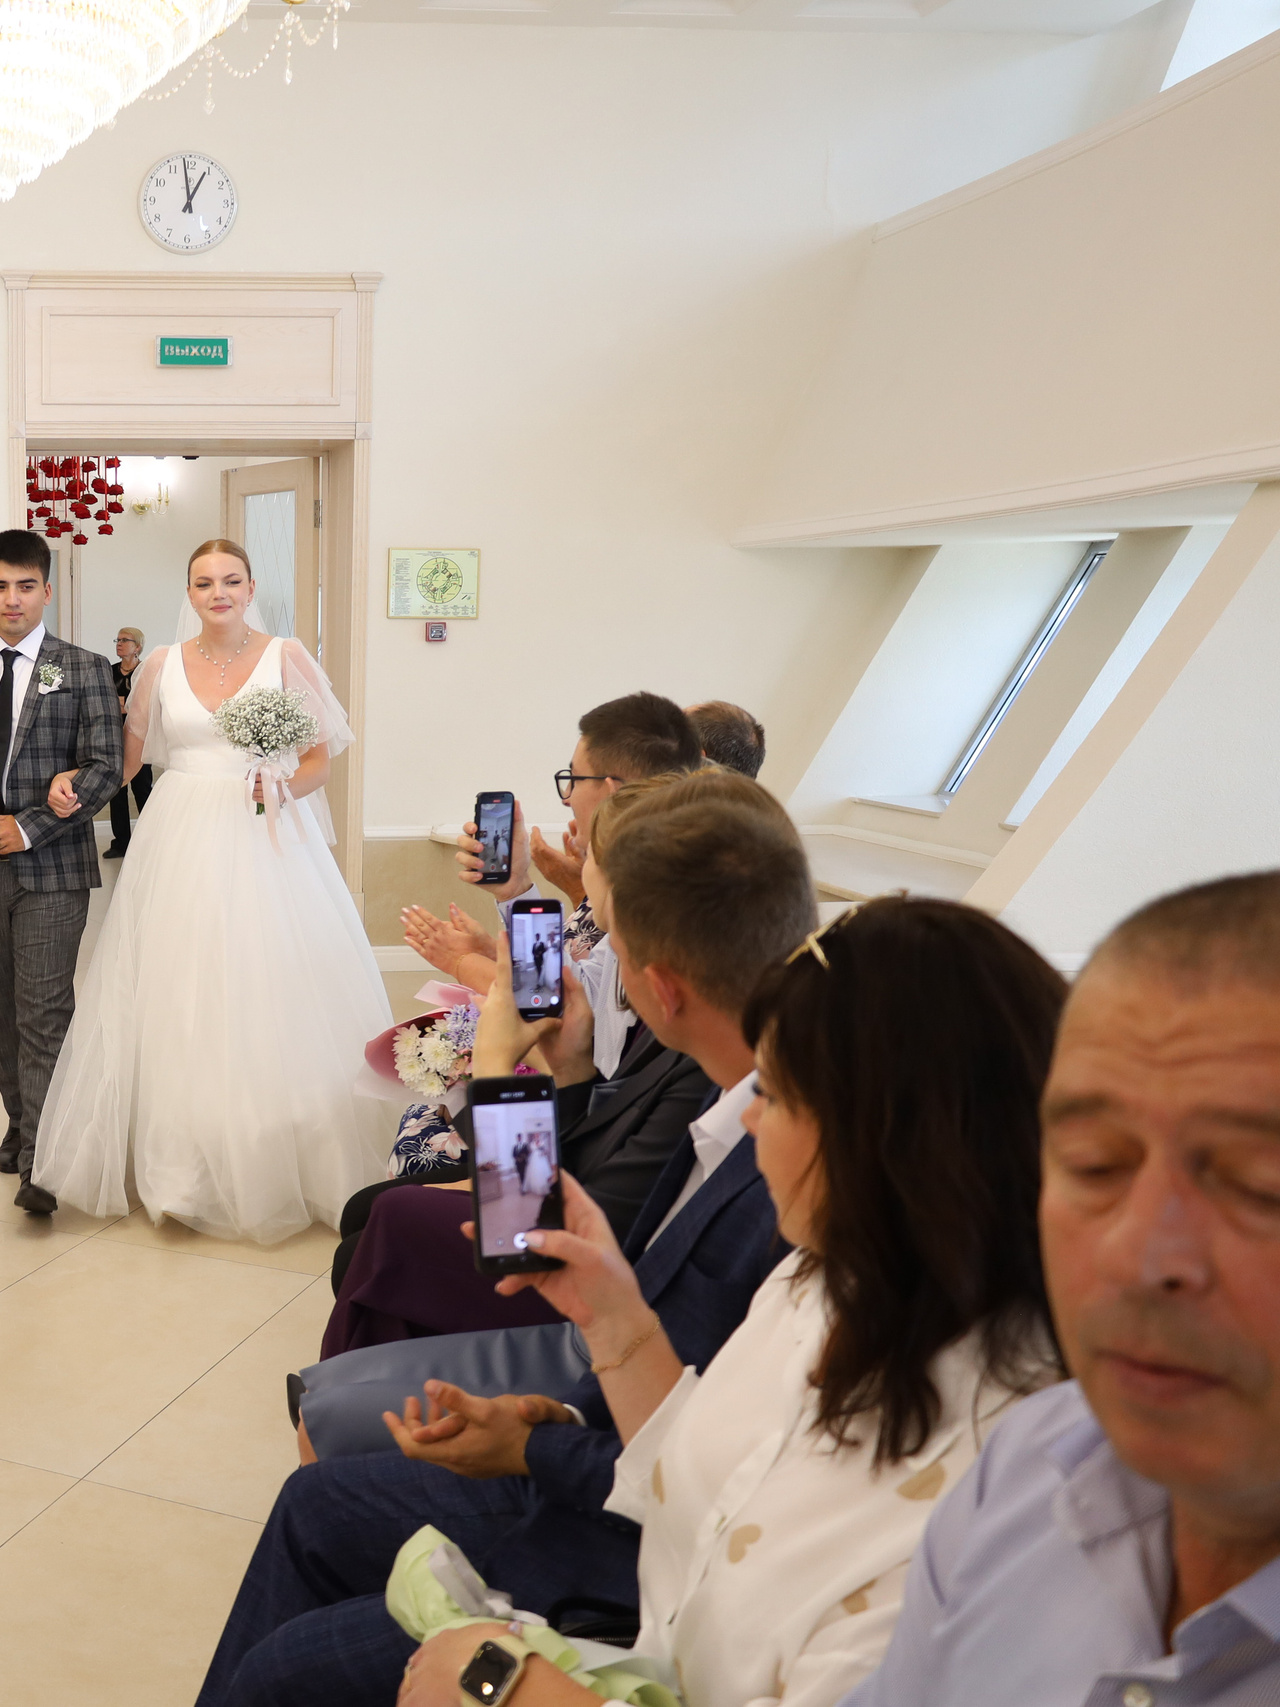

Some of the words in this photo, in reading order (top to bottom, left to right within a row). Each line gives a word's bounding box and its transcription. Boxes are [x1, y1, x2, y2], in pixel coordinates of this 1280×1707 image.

[168, 165, 177, 174] 11
[186, 161, 197, 170] 12
[206, 166, 211, 176] 1
[155, 178, 166, 187] 10
[217, 181, 224, 190] 2
[149, 196, 156, 205] 9
[223, 199, 229, 209] 3
[154, 213, 161, 222] 8
[216, 216, 222, 225] 4
[166, 228, 173, 237] 7
[204, 230, 211, 239] 5
[184, 235, 191, 244] 6
[164, 344, 224, 359] ВЫХОД
